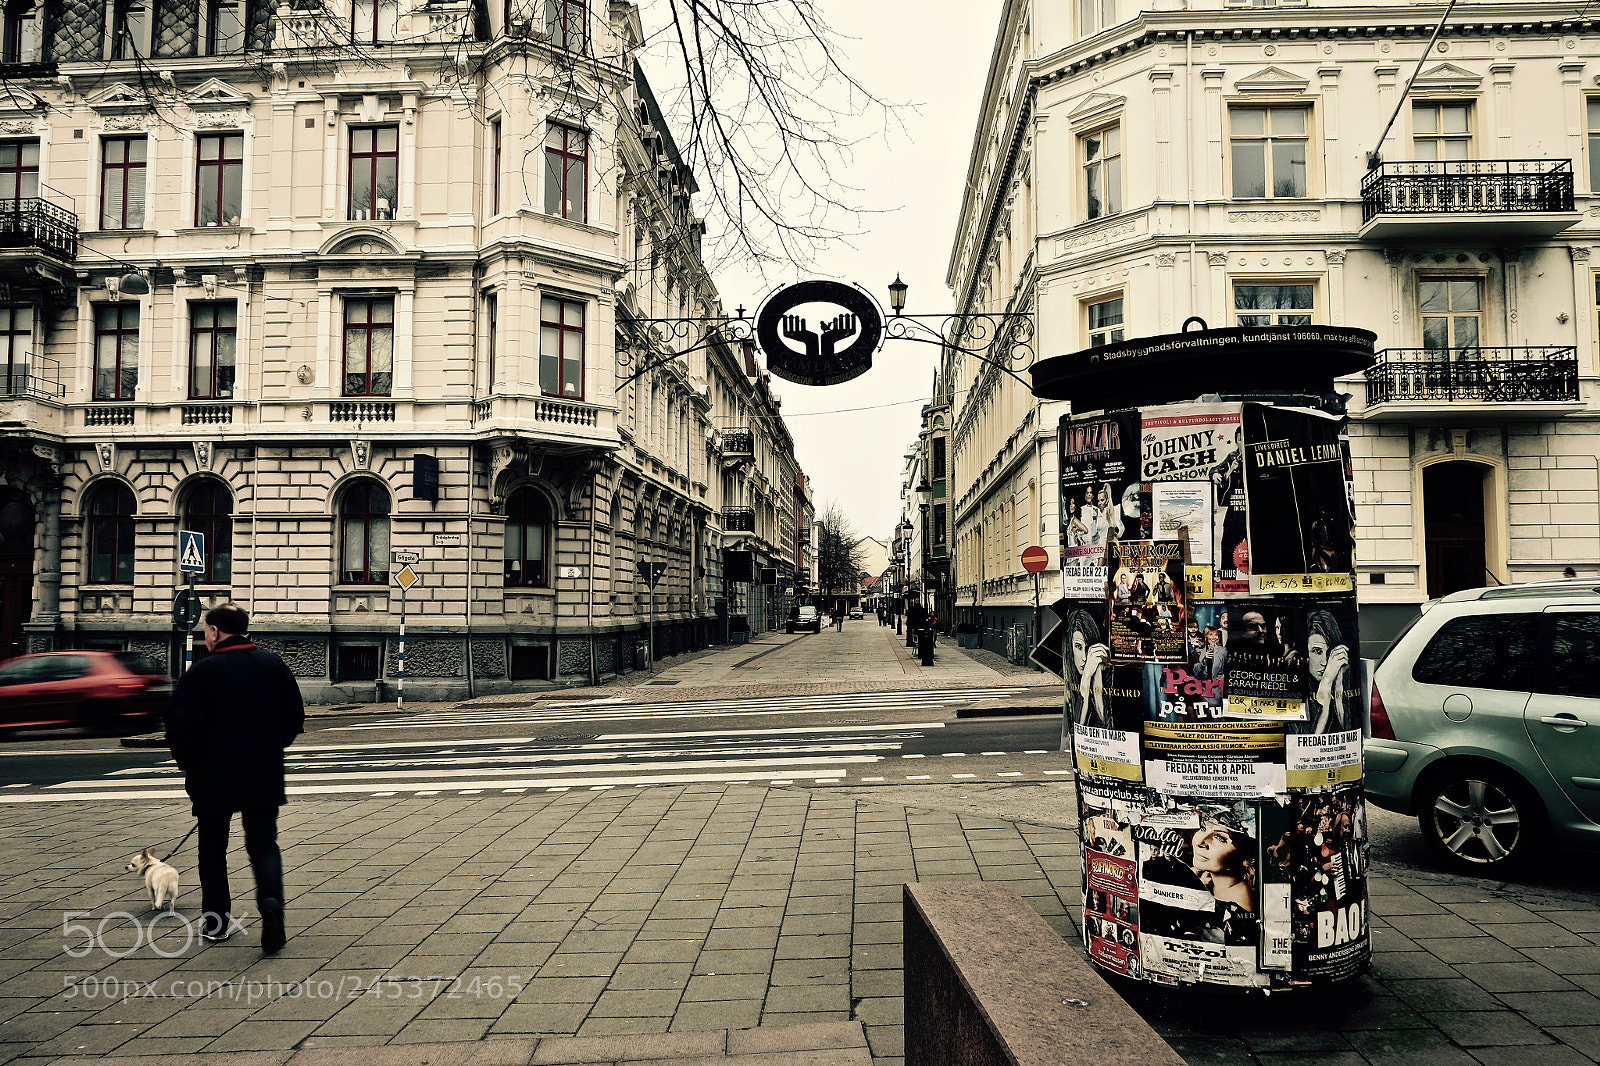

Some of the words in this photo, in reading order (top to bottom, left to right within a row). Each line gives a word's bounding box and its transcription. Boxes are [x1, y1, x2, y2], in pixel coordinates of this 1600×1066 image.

[1103, 336, 1240, 361] Stadsbyggnadsförvaltningen,
[1243, 332, 1290, 342] kundtjänst
[1292, 332, 1322, 341] 106060,
[770, 364, 814, 385] BRUKSGATAN
[825, 363, 867, 385] MARIAGATAN
[1064, 421, 1121, 457] ALCAZAR
[1142, 433, 1157, 444] The
[1142, 429, 1215, 460] JOHNNY
[1143, 448, 1217, 478] CASH
[1255, 447, 1307, 468] DANIEL
[1151, 466, 1209, 481] ADSHOW
[1112, 543, 1180, 559] NEWROZ
[1082, 567, 1094, 577] DEN
[1095, 567, 1102, 577] 22
[1280, 577, 1298, 589] 5/3
[1228, 669, 1262, 681] GEORG
[1263, 672, 1291, 683] RIEDEL
[1292, 674, 1299, 683] &
[1228, 678, 1259, 689] SARAH
[1260, 681, 1288, 691] RIEDEL
[1158, 696, 1188, 718] på
[1089, 728, 1100, 739] DEN
[1108, 730, 1127, 742] MARS
[1297, 735, 1327, 747] FREDAG
[1328, 734, 1340, 745] DEN
[1346, 731, 1358, 742] MARS
[1165, 762, 1199, 774] FREDAG
[1201, 764, 1219, 774] DEN
[1221, 764, 1228, 774] 8
[1229, 764, 1256, 775] APRIL
[1153, 888, 1184, 900] DUNKERS
[1272, 938, 1288, 949] THE
[1308, 953, 1328, 961] BENNY
